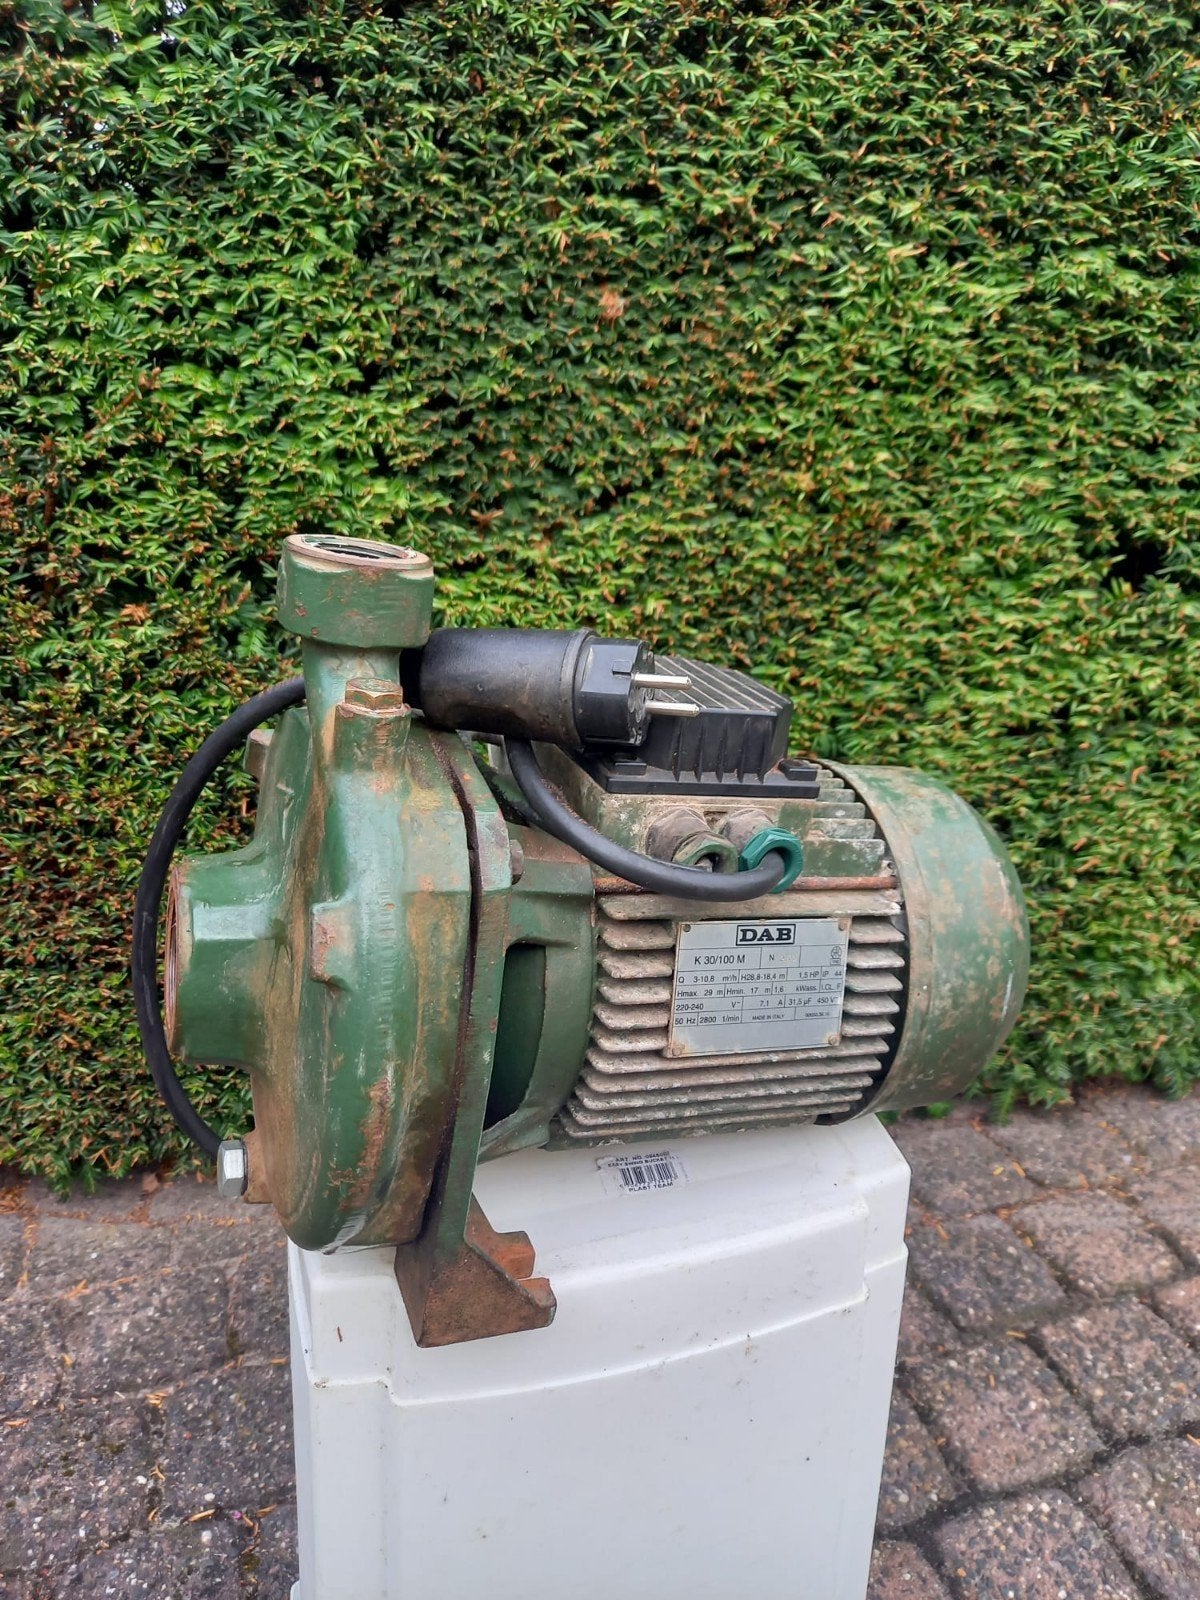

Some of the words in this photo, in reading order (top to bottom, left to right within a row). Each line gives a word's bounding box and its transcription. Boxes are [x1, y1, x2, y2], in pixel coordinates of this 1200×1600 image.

[739, 928, 792, 942] DAB
[694, 956, 701, 965] K
[704, 955, 735, 965] 30/100
[737, 954, 745, 963] M
[676, 1003, 704, 1011] 220-240
[675, 1017, 683, 1025] 50
[699, 1016, 717, 1024] 2800
